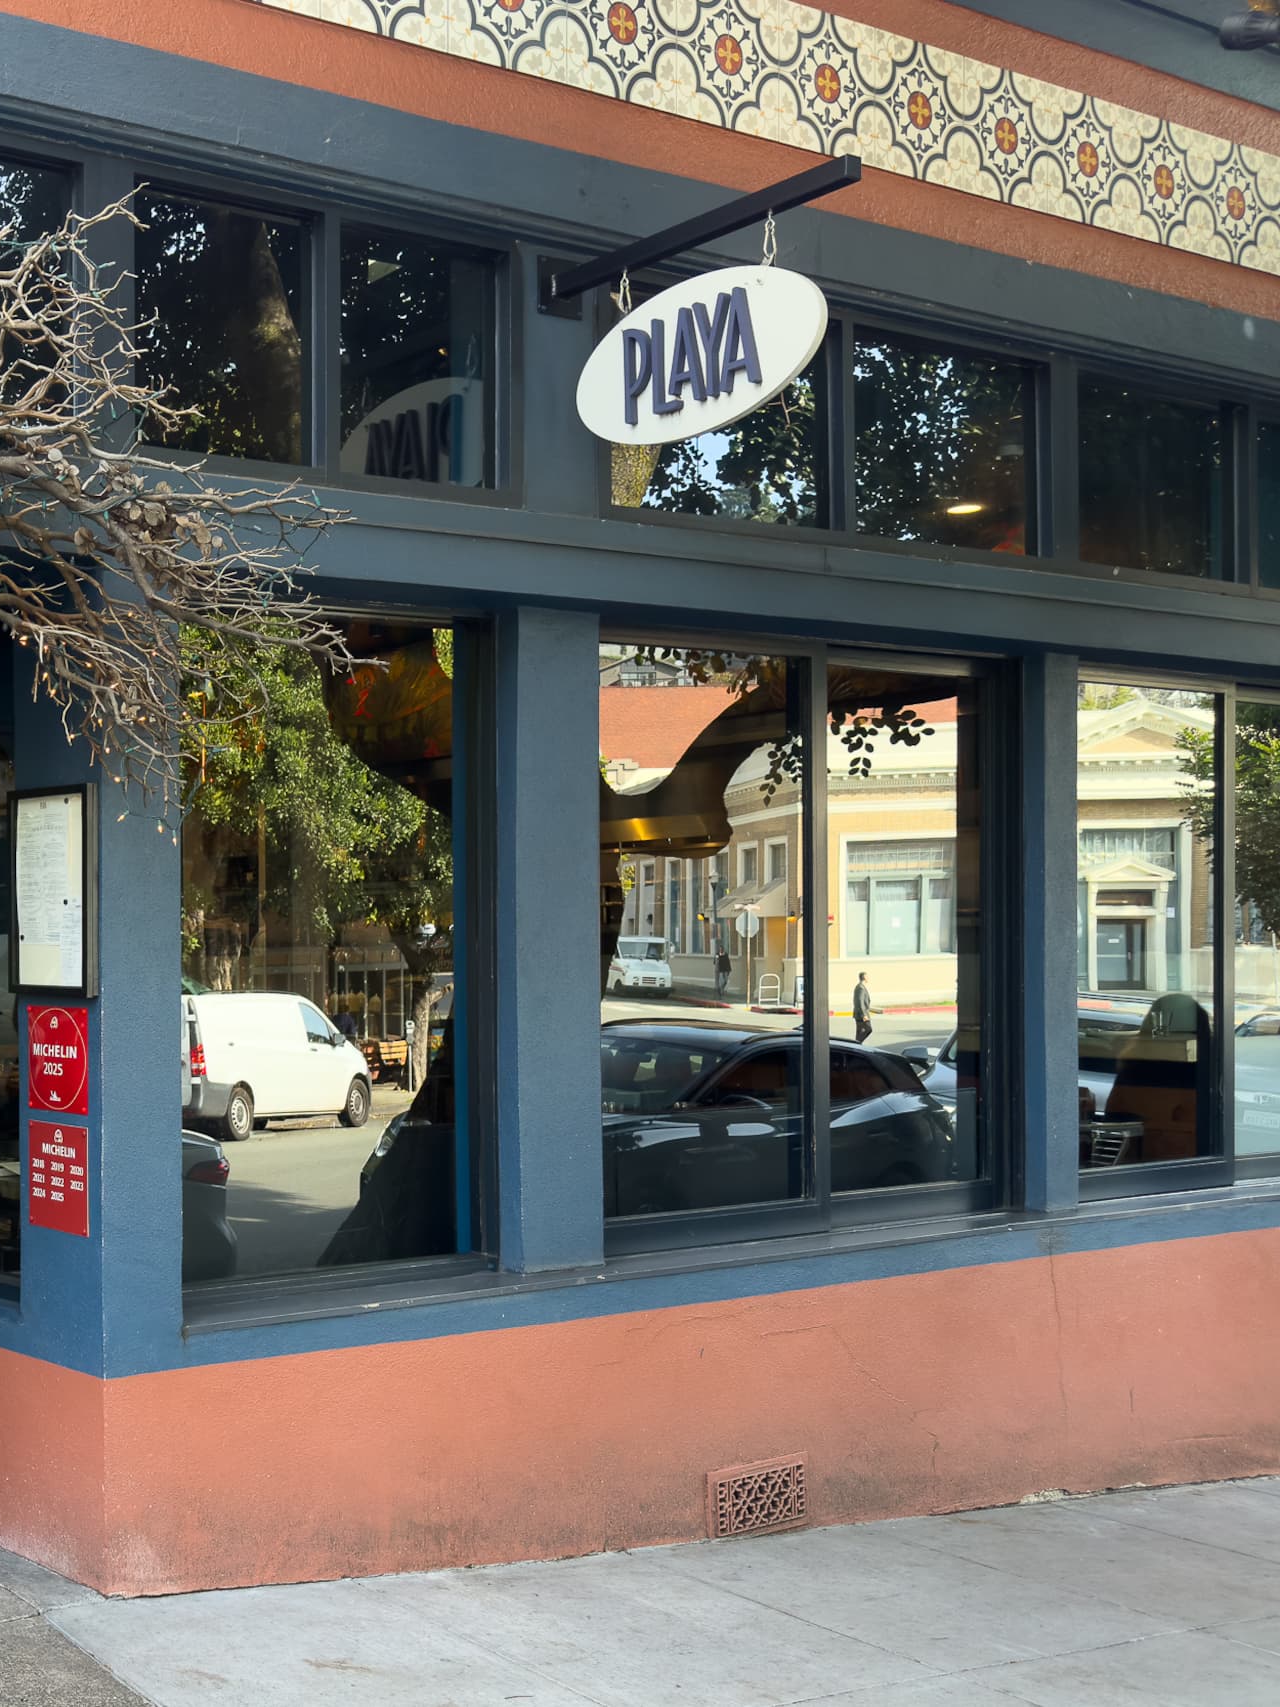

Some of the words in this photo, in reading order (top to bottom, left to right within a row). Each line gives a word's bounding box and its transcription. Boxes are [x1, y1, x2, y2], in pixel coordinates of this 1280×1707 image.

[622, 286, 762, 425] PLAYA
[33, 1043, 77, 1058] MICHELIN
[43, 1062, 63, 1076] 2025
[42, 1143, 75, 1158] MICHELIN
[51, 1161, 64, 1172] 2019
[70, 1165, 83, 1177] 2020
